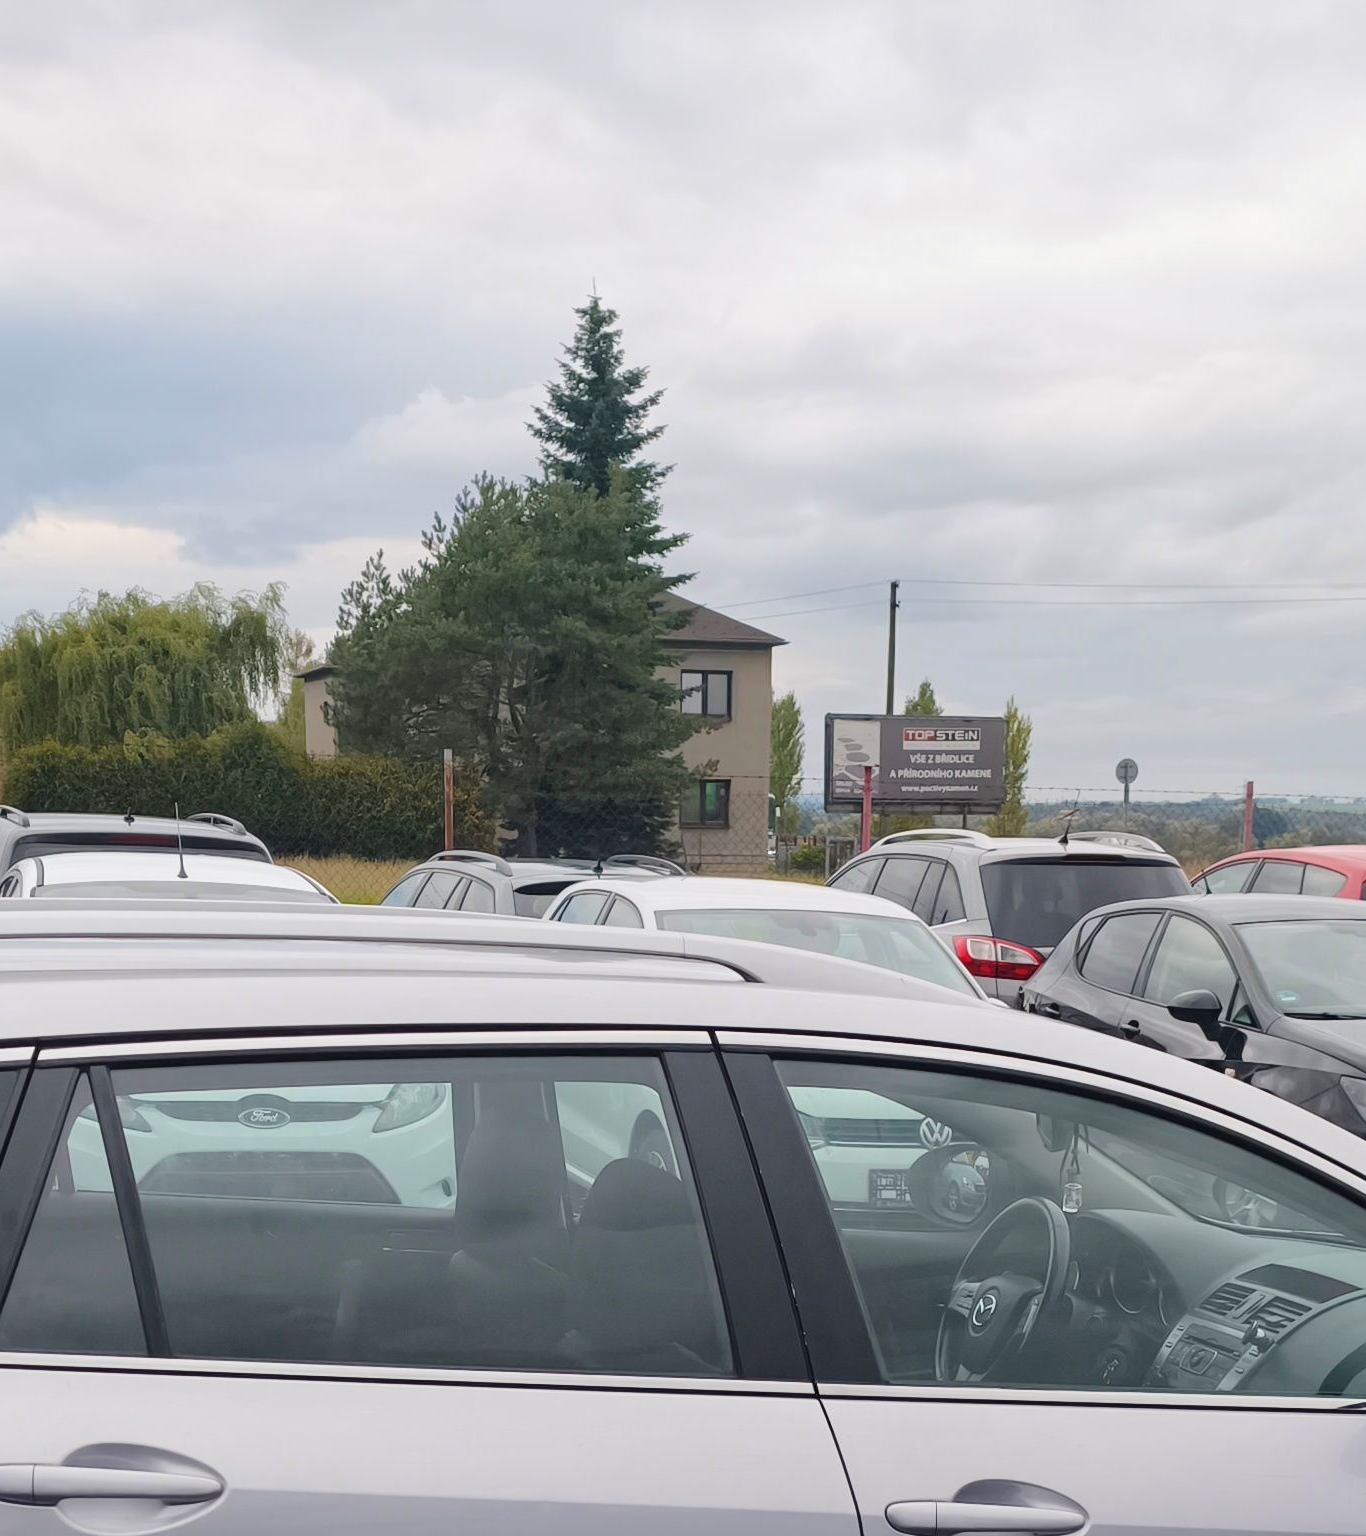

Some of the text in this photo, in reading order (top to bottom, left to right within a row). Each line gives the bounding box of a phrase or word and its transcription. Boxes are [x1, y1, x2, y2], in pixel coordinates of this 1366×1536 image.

[910, 753, 975, 763] VŠE Z BŘIDLICE
[890, 768, 992, 779] A PŘÍRODNÍHO KAMENE
[250, 1110, 279, 1122] Ford
